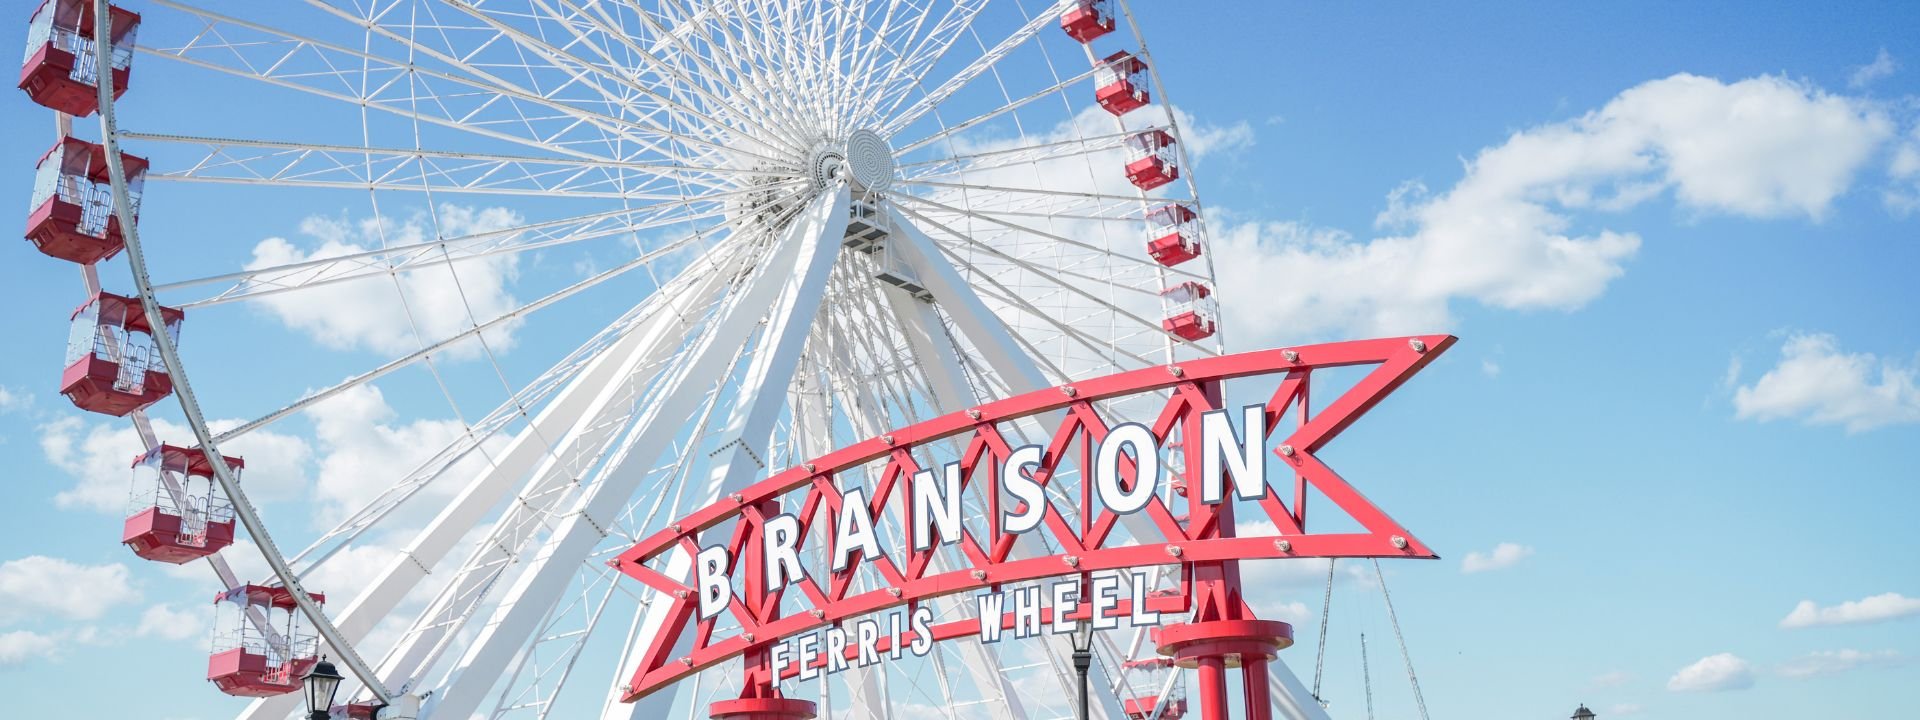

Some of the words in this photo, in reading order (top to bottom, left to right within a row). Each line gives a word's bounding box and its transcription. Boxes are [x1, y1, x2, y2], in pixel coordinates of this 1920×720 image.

[696, 403, 1267, 620] BRANSON
[769, 606, 934, 689] FERRIS
[976, 572, 1161, 644] WHEEL
